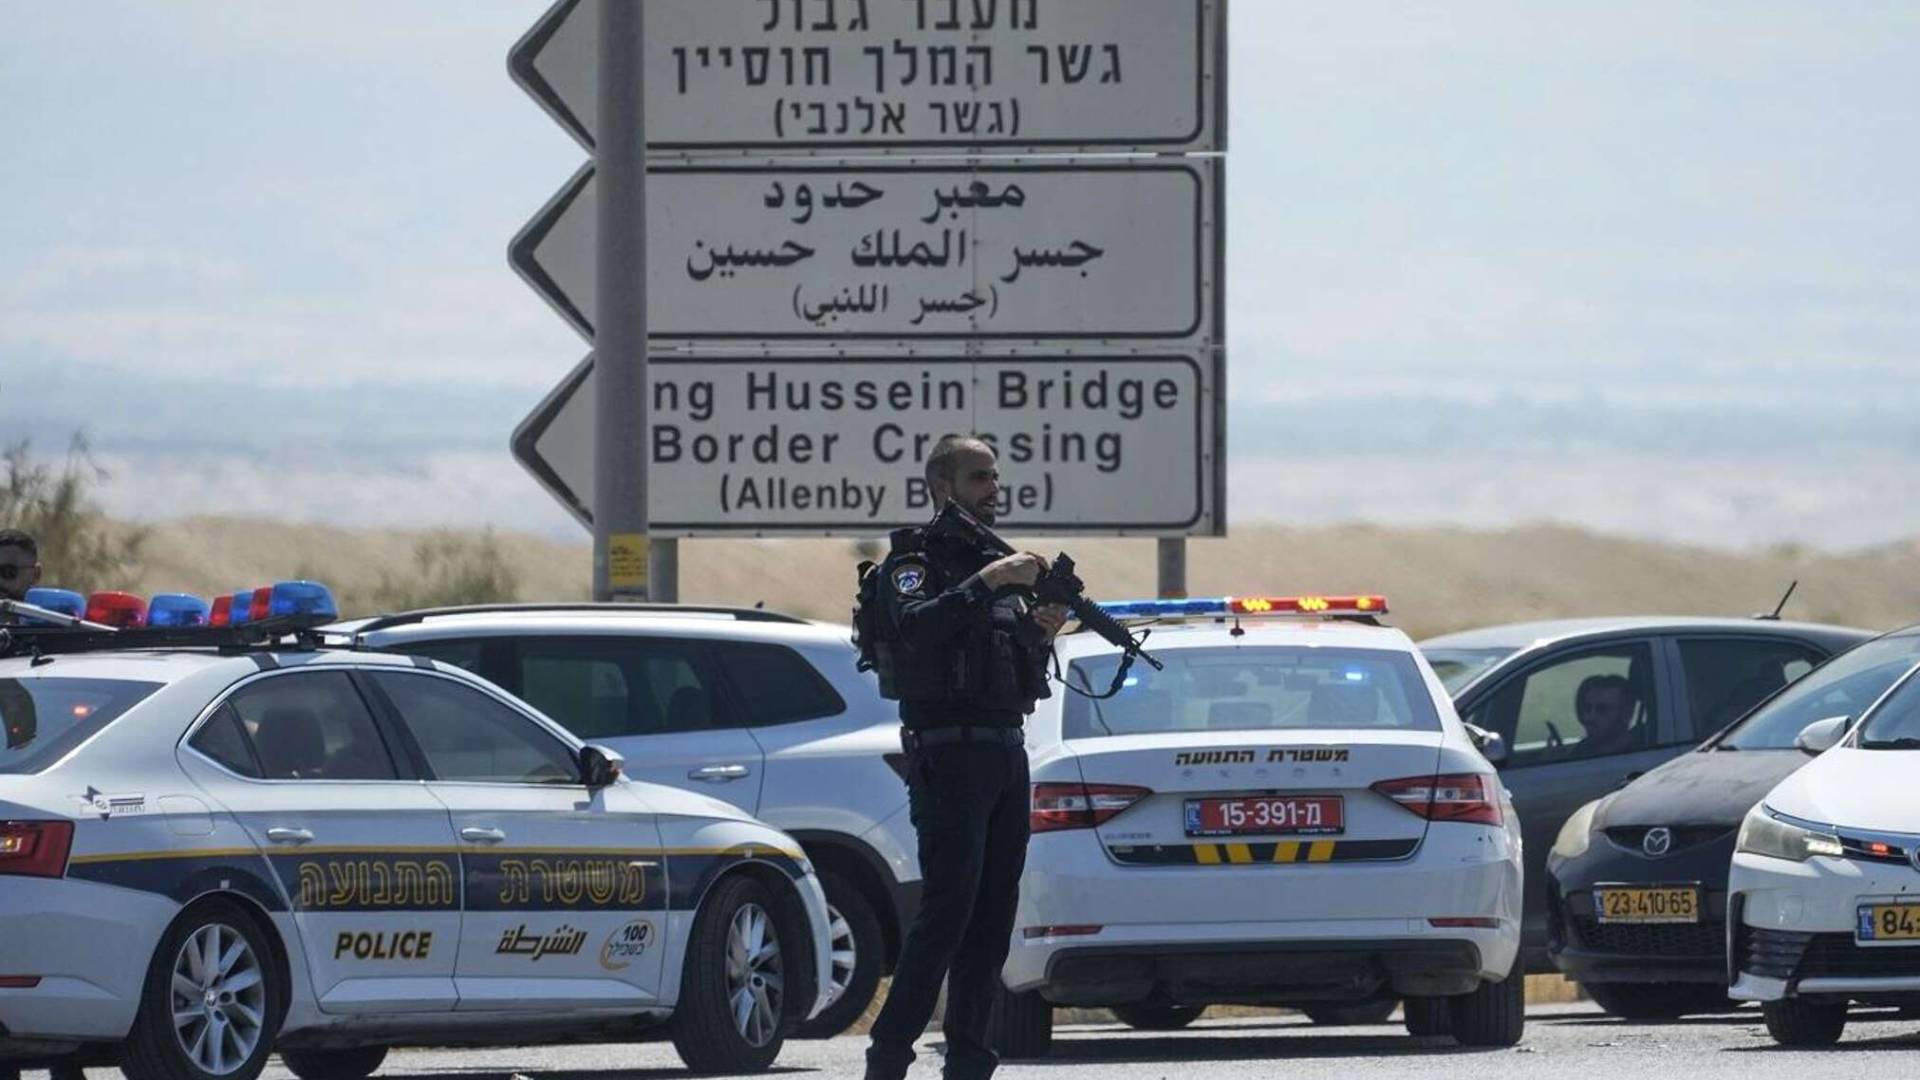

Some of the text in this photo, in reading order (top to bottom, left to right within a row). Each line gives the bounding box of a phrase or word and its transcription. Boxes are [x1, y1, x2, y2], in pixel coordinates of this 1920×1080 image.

[672, 38, 1122, 94] גשר המלך חוסיין
[773, 96, 1020, 138] (גשר אלנבי)
[763, 181, 1026, 225] معبر حدود
[686, 228, 1105, 284] جسر الملك حسين
[793, 283, 998, 327] (جسر اللنبي)
[653, 369, 1179, 422] ng Hussein Bridge
[652, 422, 1122, 473] Border Crssing
[719, 472, 1053, 518] (Allenby Bge)
[1175, 750, 1349, 766] משטרת התנועה
[300, 859, 646, 906] משטרת התנועה
[334, 931, 433, 960] POLICE
[495, 924, 588, 962] الشرطة
[623, 925, 648, 941] 100
